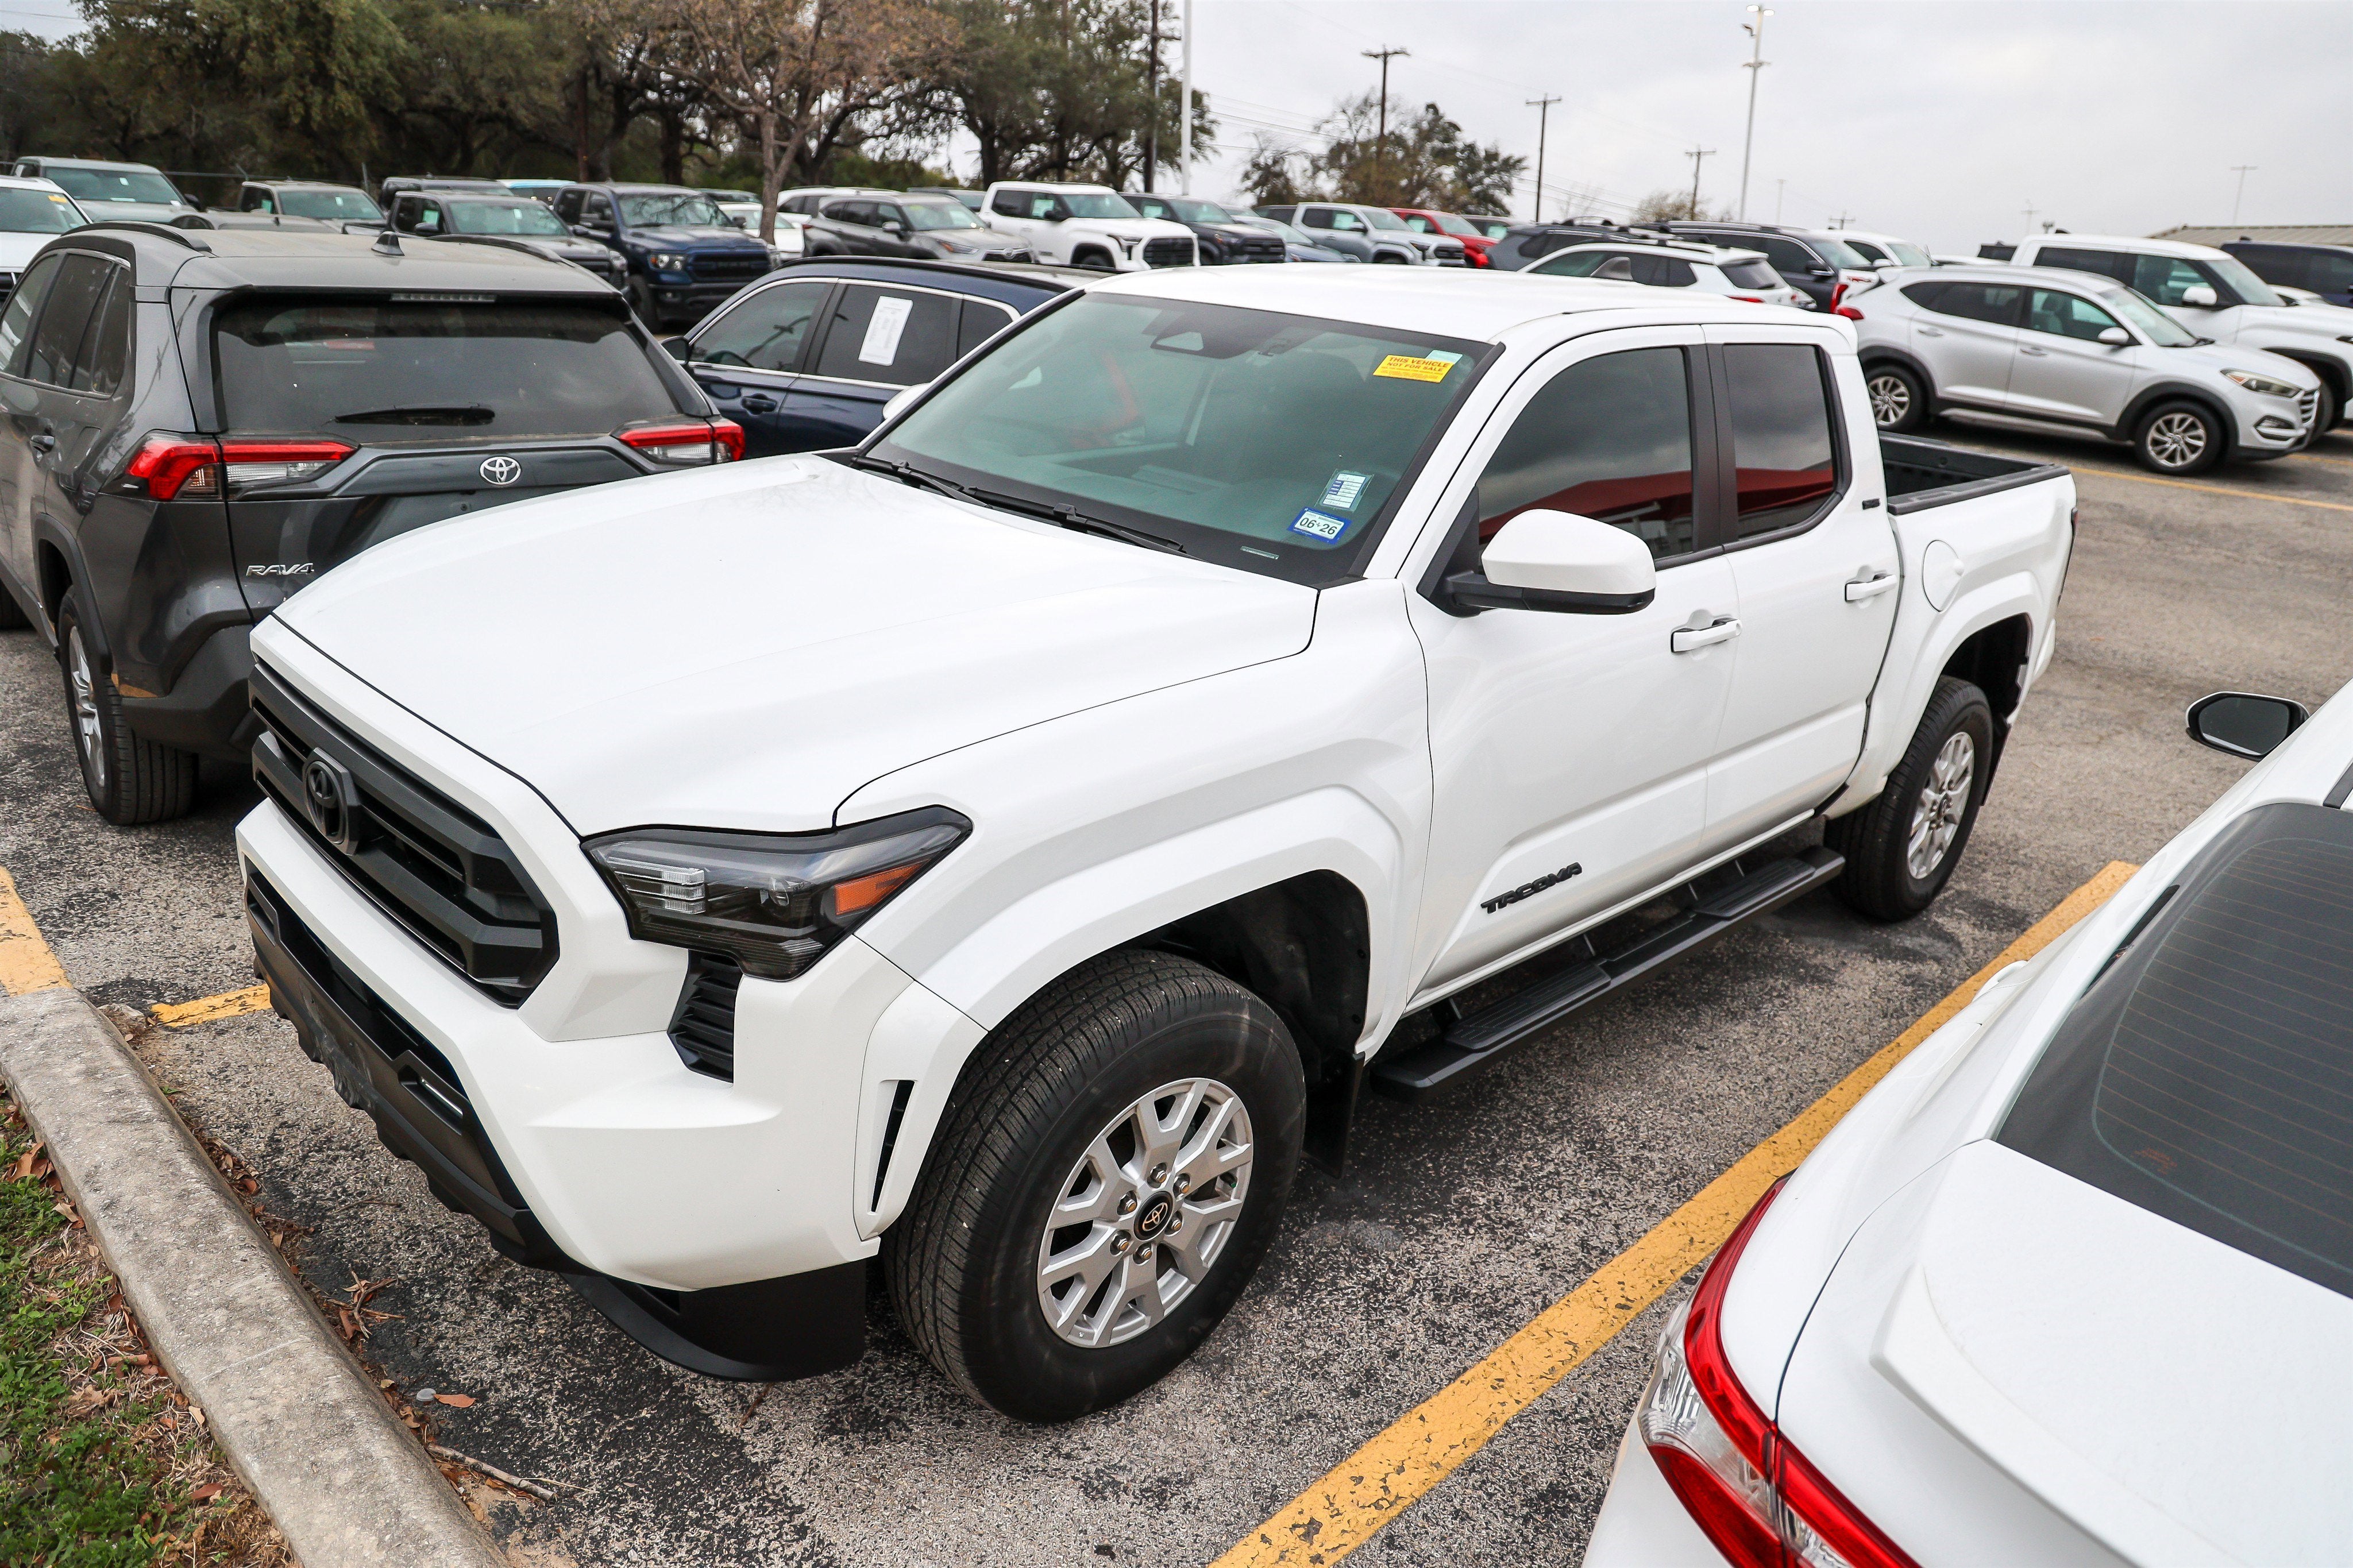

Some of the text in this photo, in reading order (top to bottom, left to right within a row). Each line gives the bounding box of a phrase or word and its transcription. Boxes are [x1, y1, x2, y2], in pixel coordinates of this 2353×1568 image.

[1411, 358, 1450, 368] VEHICLE
[1300, 517, 1317, 528] 06
[1320, 524, 1337, 535] 26
[246, 563, 314, 576] RAV4
[1480, 862, 1582, 914] TACOMA
